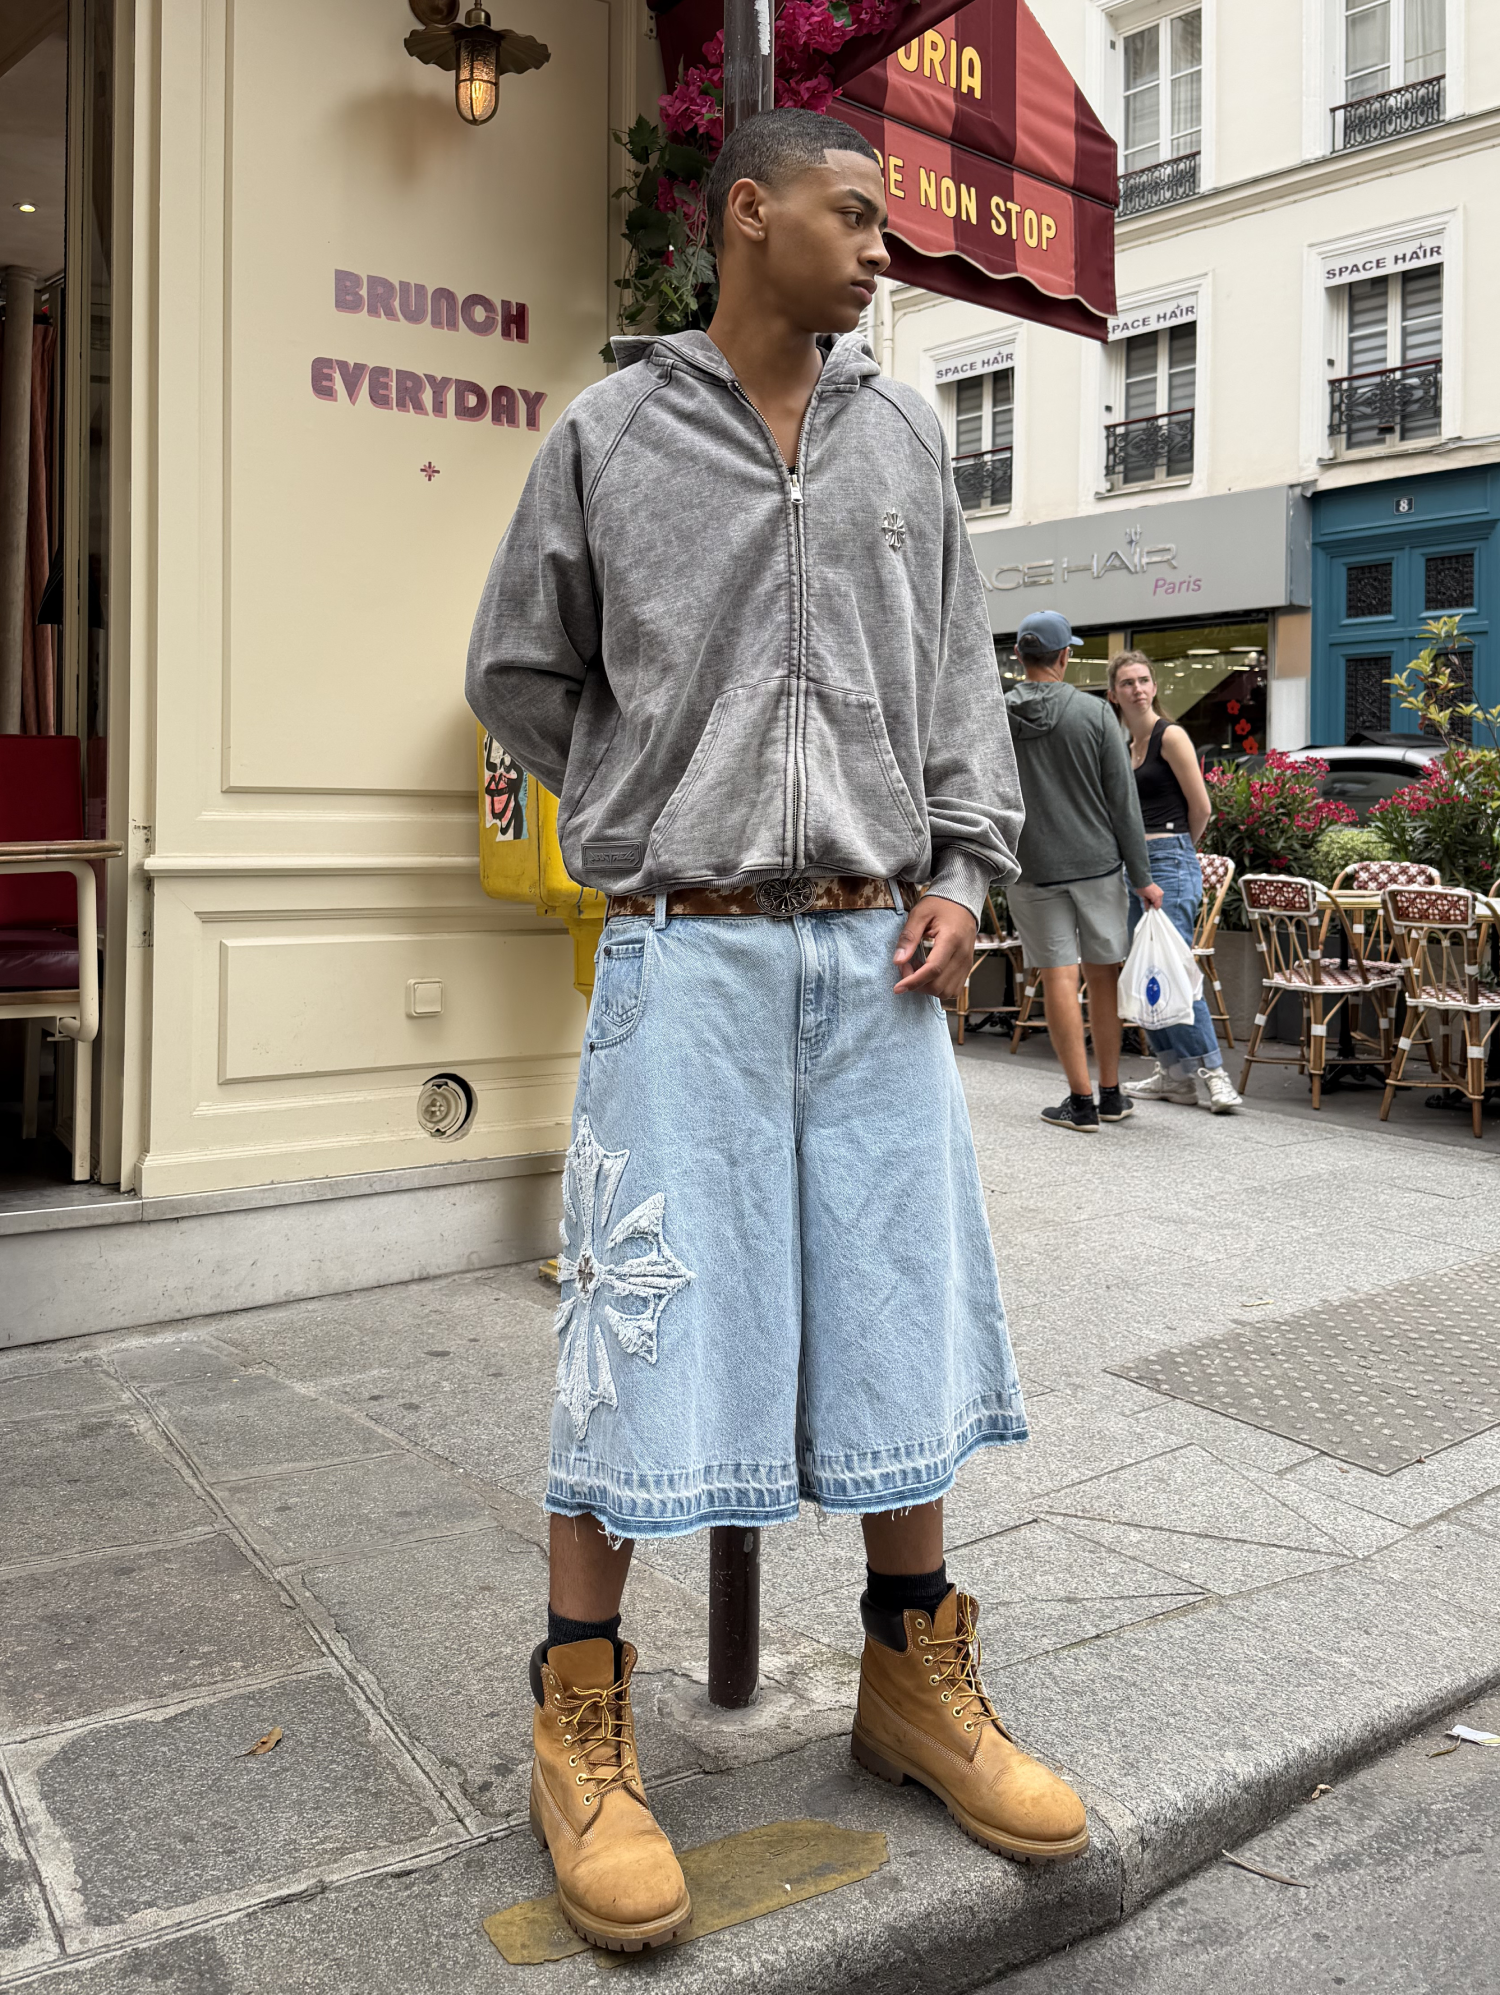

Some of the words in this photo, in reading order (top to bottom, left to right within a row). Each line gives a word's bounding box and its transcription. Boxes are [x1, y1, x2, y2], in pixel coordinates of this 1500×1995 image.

[919, 166, 977, 226] NON
[990, 195, 1057, 251] STOP
[1325, 257, 1387, 279] SPACE
[1394, 245, 1442, 265] HAIR
[334, 268, 530, 345] BRUNCH
[1107, 316, 1151, 335] PACE
[1156, 305, 1196, 324] HAIR
[936, 361, 978, 379] SPACE
[981, 352, 1015, 369] HAIR
[310, 356, 548, 433] EVERYDAY
[1399, 498, 1409, 512] 8
[1062, 543, 1178, 583] HAIR
[1152, 575, 1203, 597] Paris
